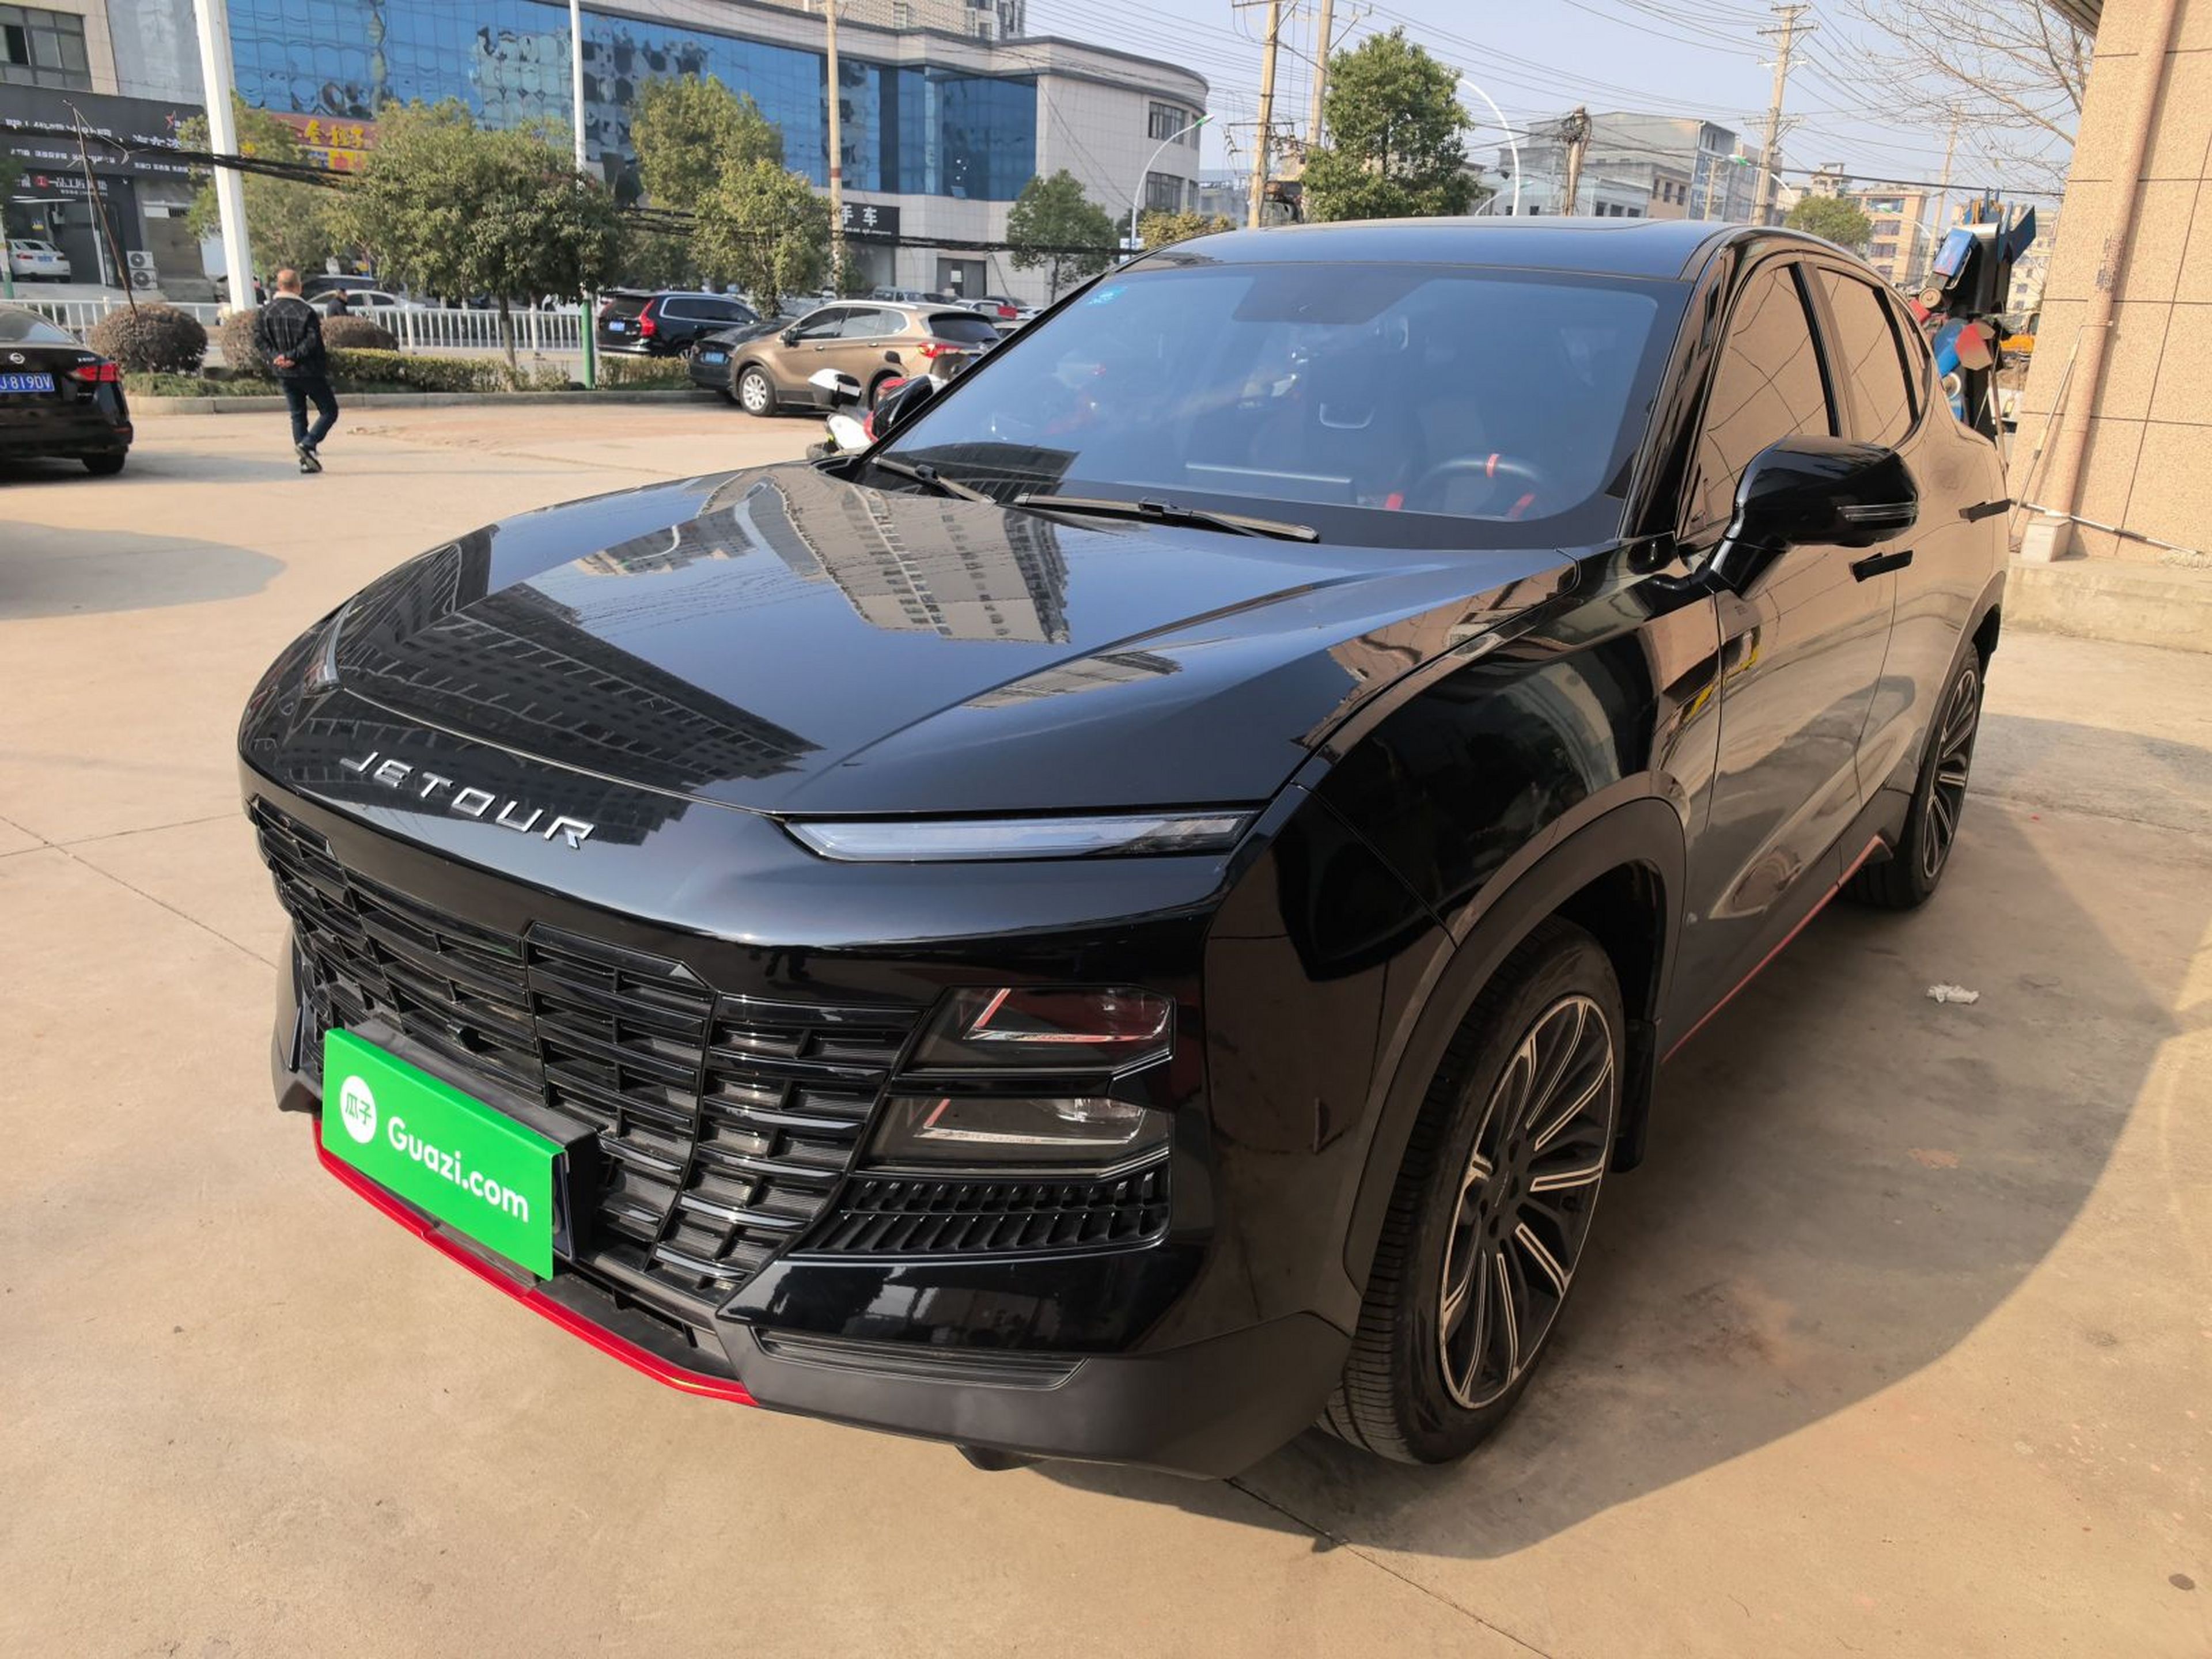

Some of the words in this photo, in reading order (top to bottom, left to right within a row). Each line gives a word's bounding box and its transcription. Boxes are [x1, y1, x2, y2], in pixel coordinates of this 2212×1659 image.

[339, 752, 594, 850] JETOUR
[345, 1092, 372, 1126] 瓜子
[387, 1116, 529, 1223] Guazi.com
